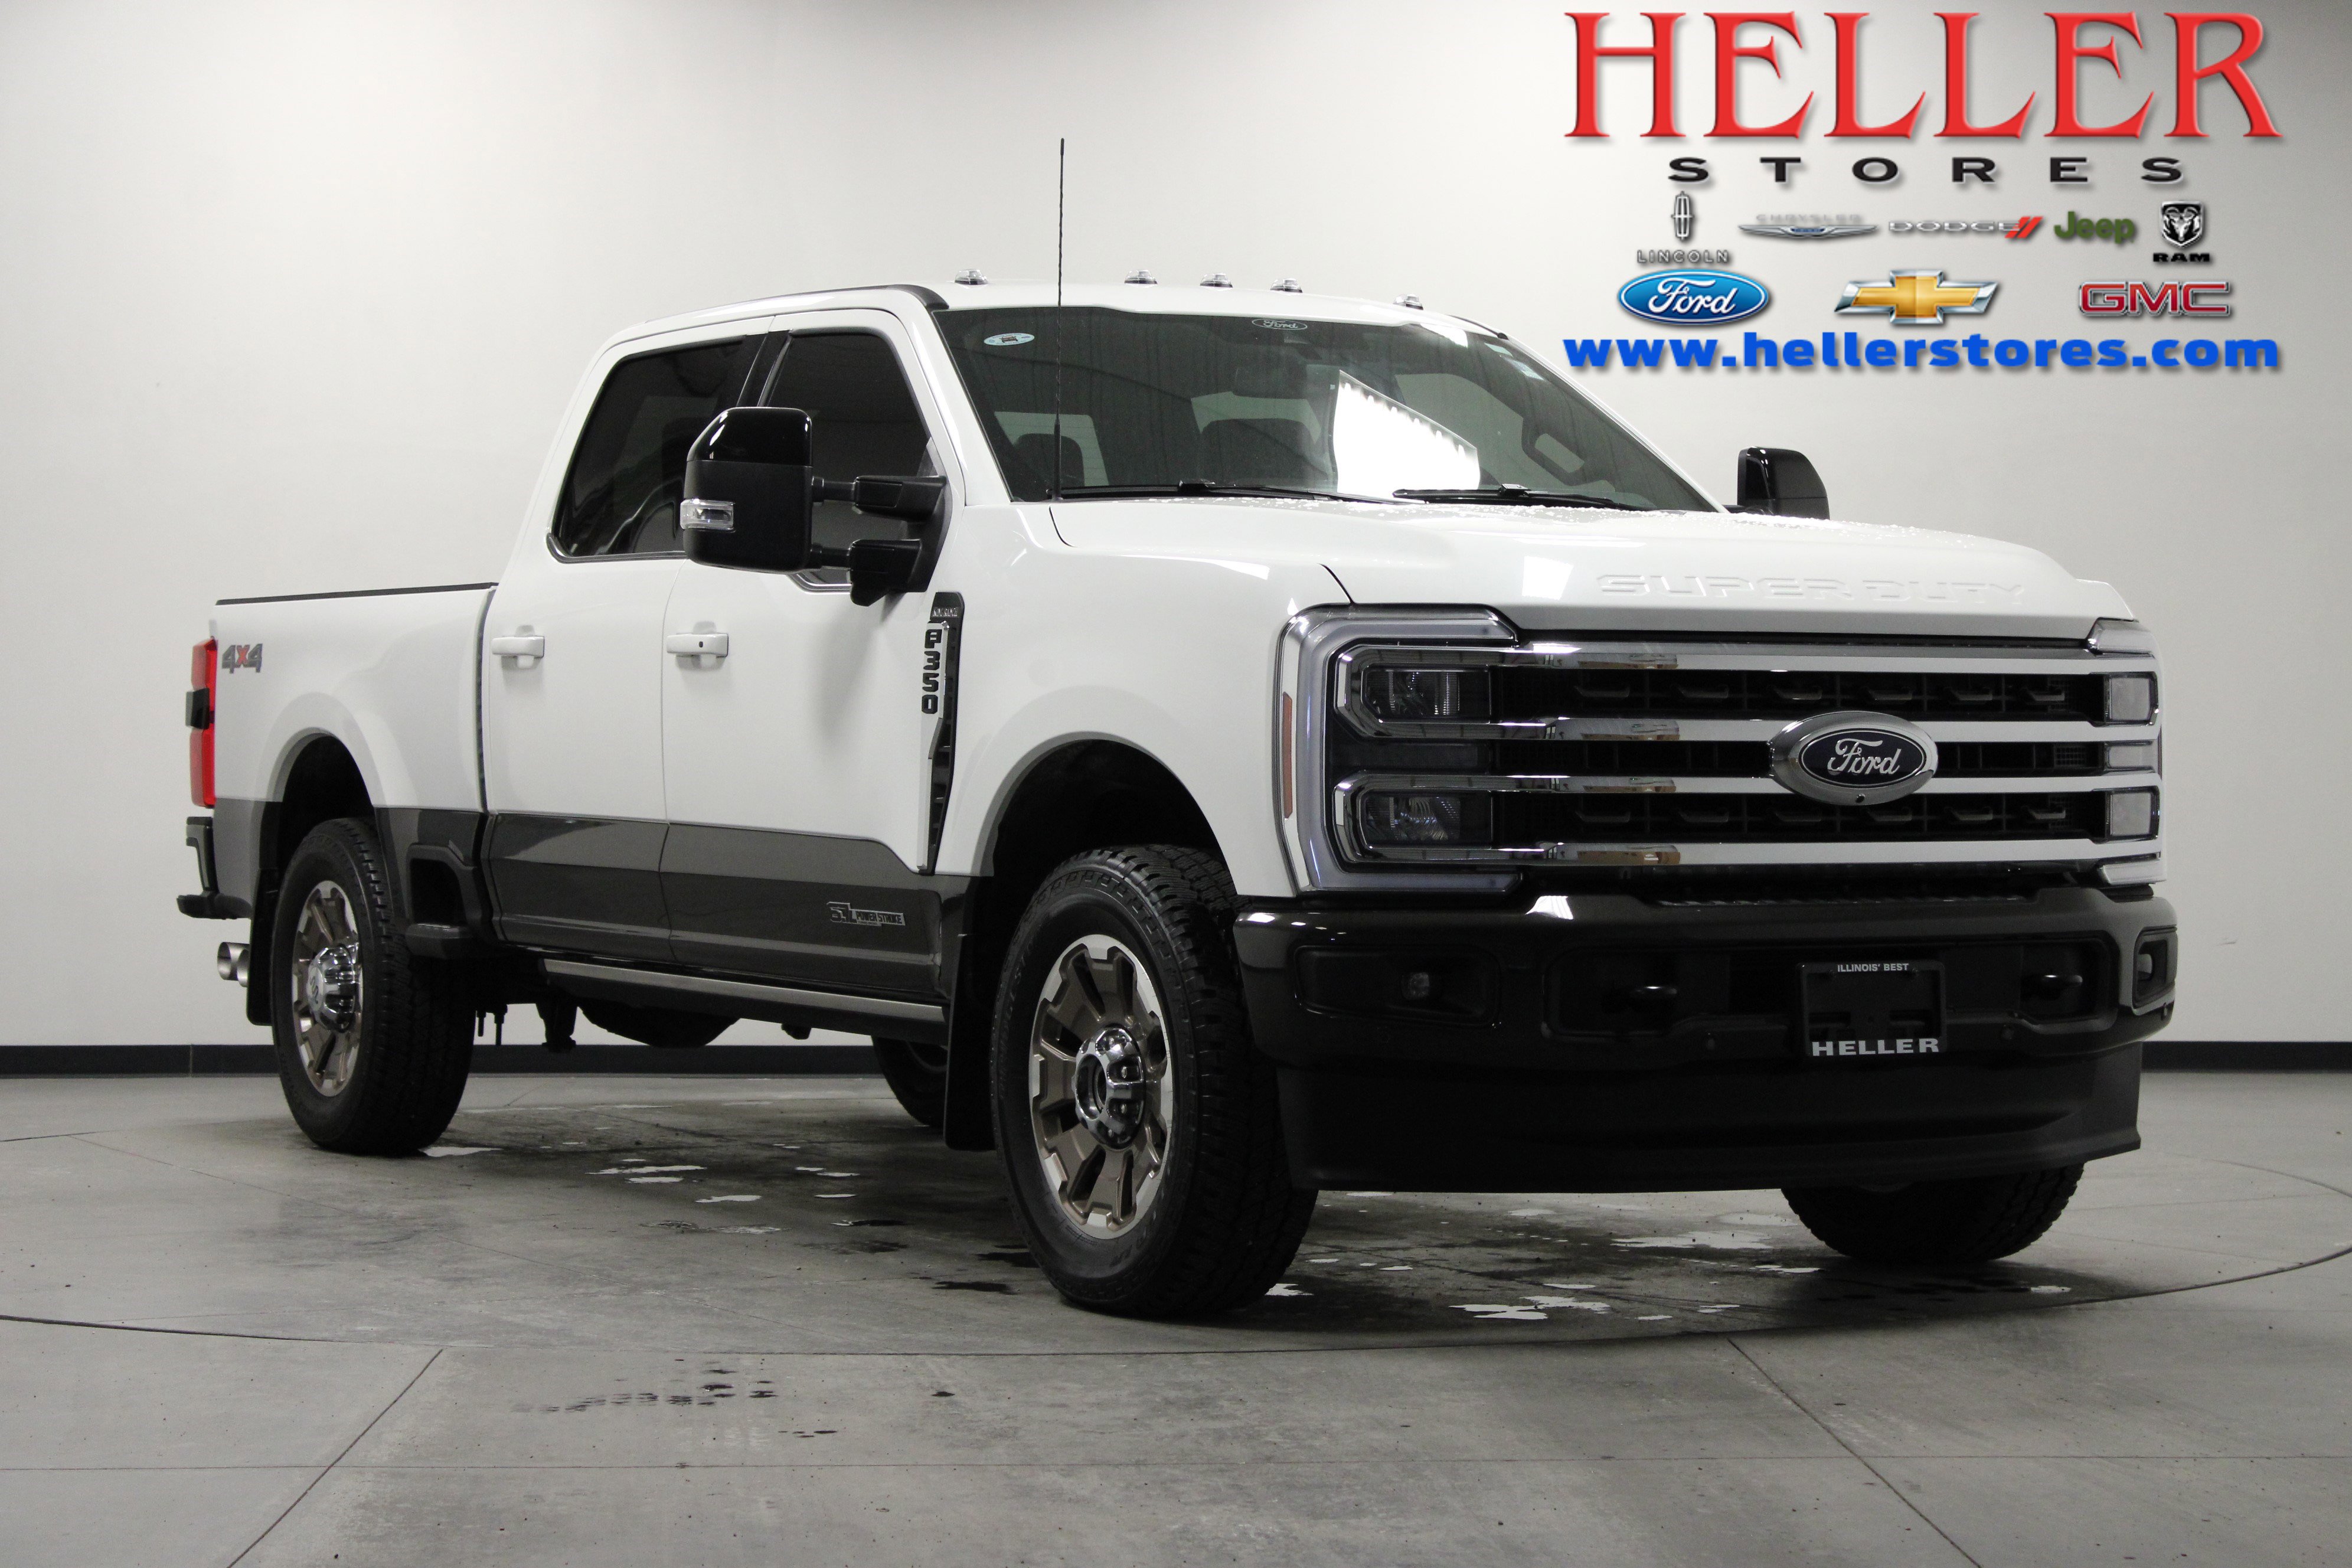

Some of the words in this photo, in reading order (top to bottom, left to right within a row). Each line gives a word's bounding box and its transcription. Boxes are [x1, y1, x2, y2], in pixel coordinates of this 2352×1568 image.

[1263, 319, 1299, 329] Ford
[1596, 574, 1855, 601] SUPER
[1862, 580, 2024, 605] DUTY
[1827, 738, 1902, 775] Ford
[1837, 963, 1881, 972] ILLINOIS'
[1883, 963, 1909, 971] BEST
[1812, 1038, 1939, 1056] HELLER
